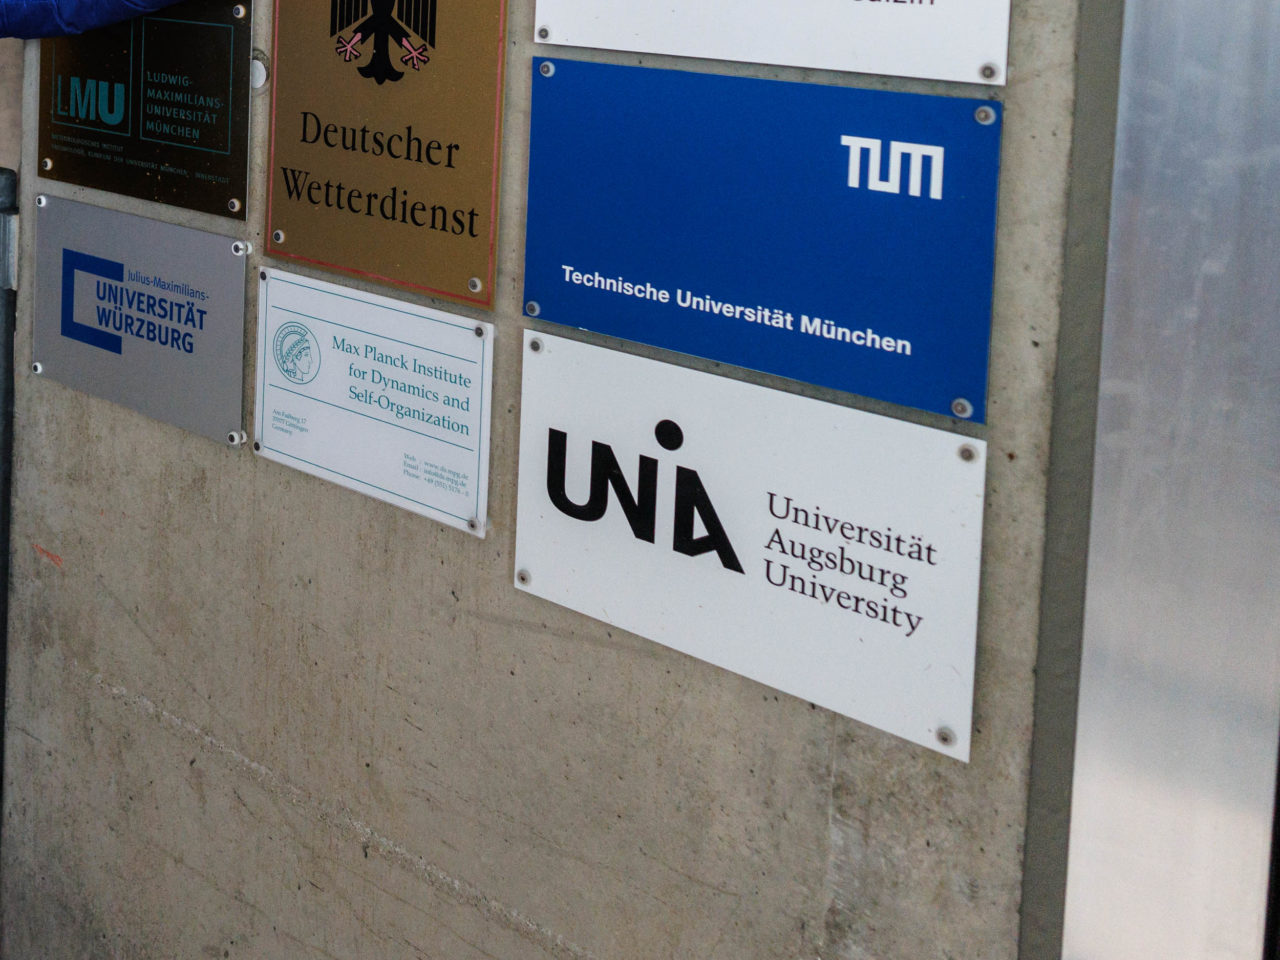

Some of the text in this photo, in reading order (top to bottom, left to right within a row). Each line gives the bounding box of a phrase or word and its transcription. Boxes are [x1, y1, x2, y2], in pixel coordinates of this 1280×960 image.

[56, 74, 125, 126] LMU
[146, 71, 193, 88] LUDWIG-
[146, 88, 224, 110] MAXIMILIANS-
[145, 119, 200, 140] MÜNCHEN
[146, 103, 218, 125] UNIVERSITÄT
[300, 111, 460, 169] Deutscher
[840, 135, 944, 201] TUM
[280, 166, 480, 238] Wetterdienst
[96, 280, 208, 331] UNIVERSITÄT
[127, 268, 210, 301] Julius-Maximilians-
[96, 305, 195, 354] WÜRZBURG
[561, 264, 913, 357] Technische Universität München
[332, 335, 472, 389] Max Planck Institute
[348, 362, 470, 412] for Dynamics and
[348, 385, 470, 436] Self-Organization
[766, 491, 938, 566] Universität
[764, 527, 909, 599] Augsburg
[763, 558, 924, 637] University
